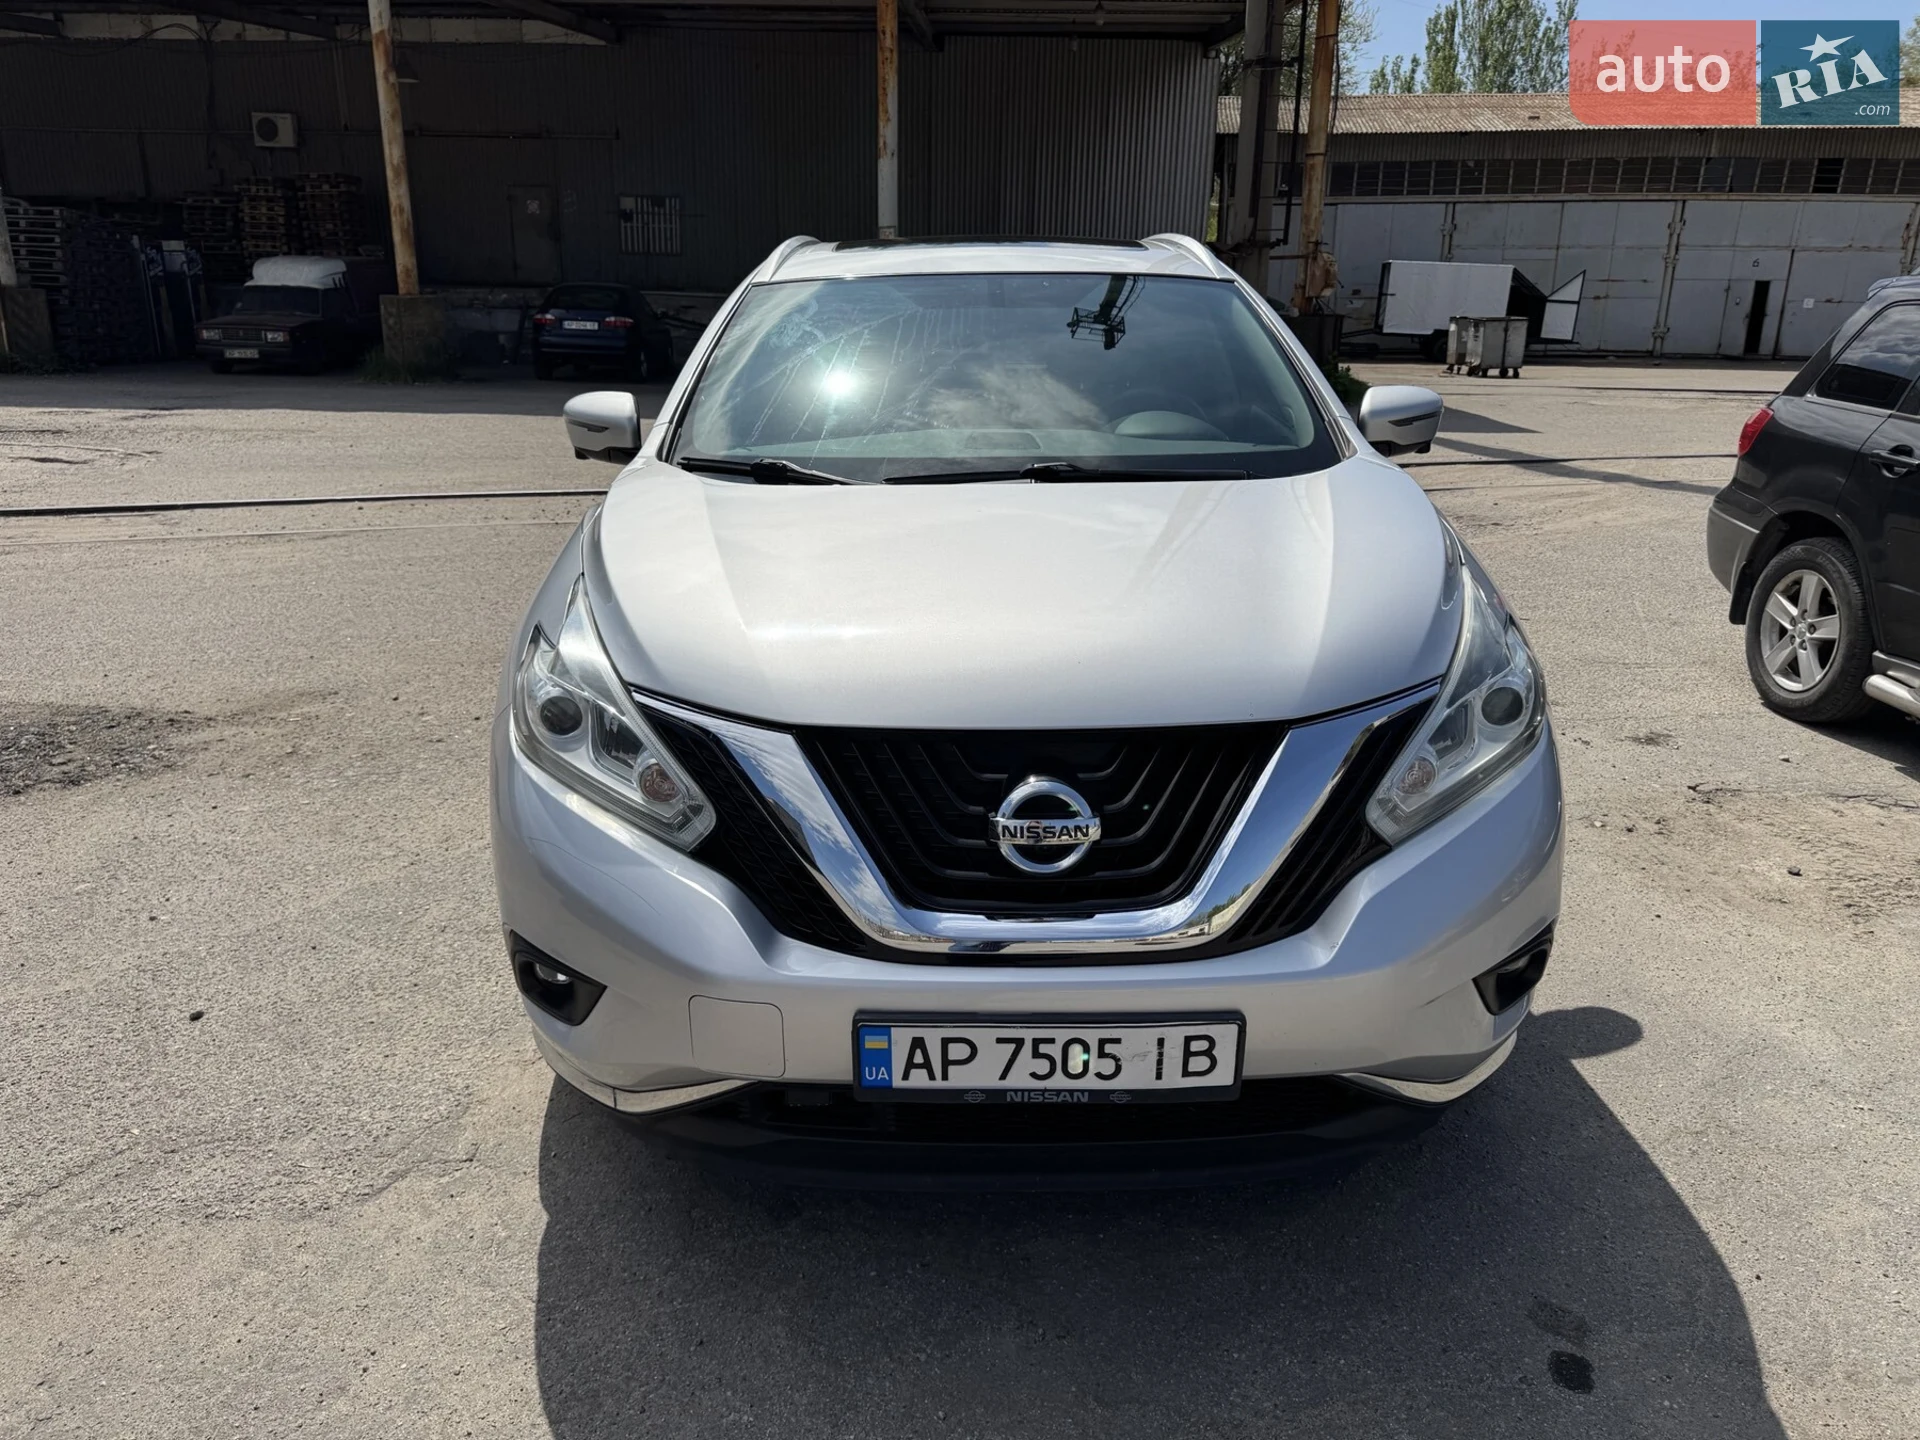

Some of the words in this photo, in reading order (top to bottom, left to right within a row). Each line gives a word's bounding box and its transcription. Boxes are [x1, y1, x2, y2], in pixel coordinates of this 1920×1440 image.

[1752, 258, 1760, 268] 6
[1001, 824, 1090, 839] NISSAN
[901, 1036, 979, 1081] AP
[995, 1036, 1123, 1081] 7505
[1154, 1034, 1218, 1081] IB
[865, 1066, 889, 1081] UA
[1006, 1090, 1089, 1103] NISSAN
